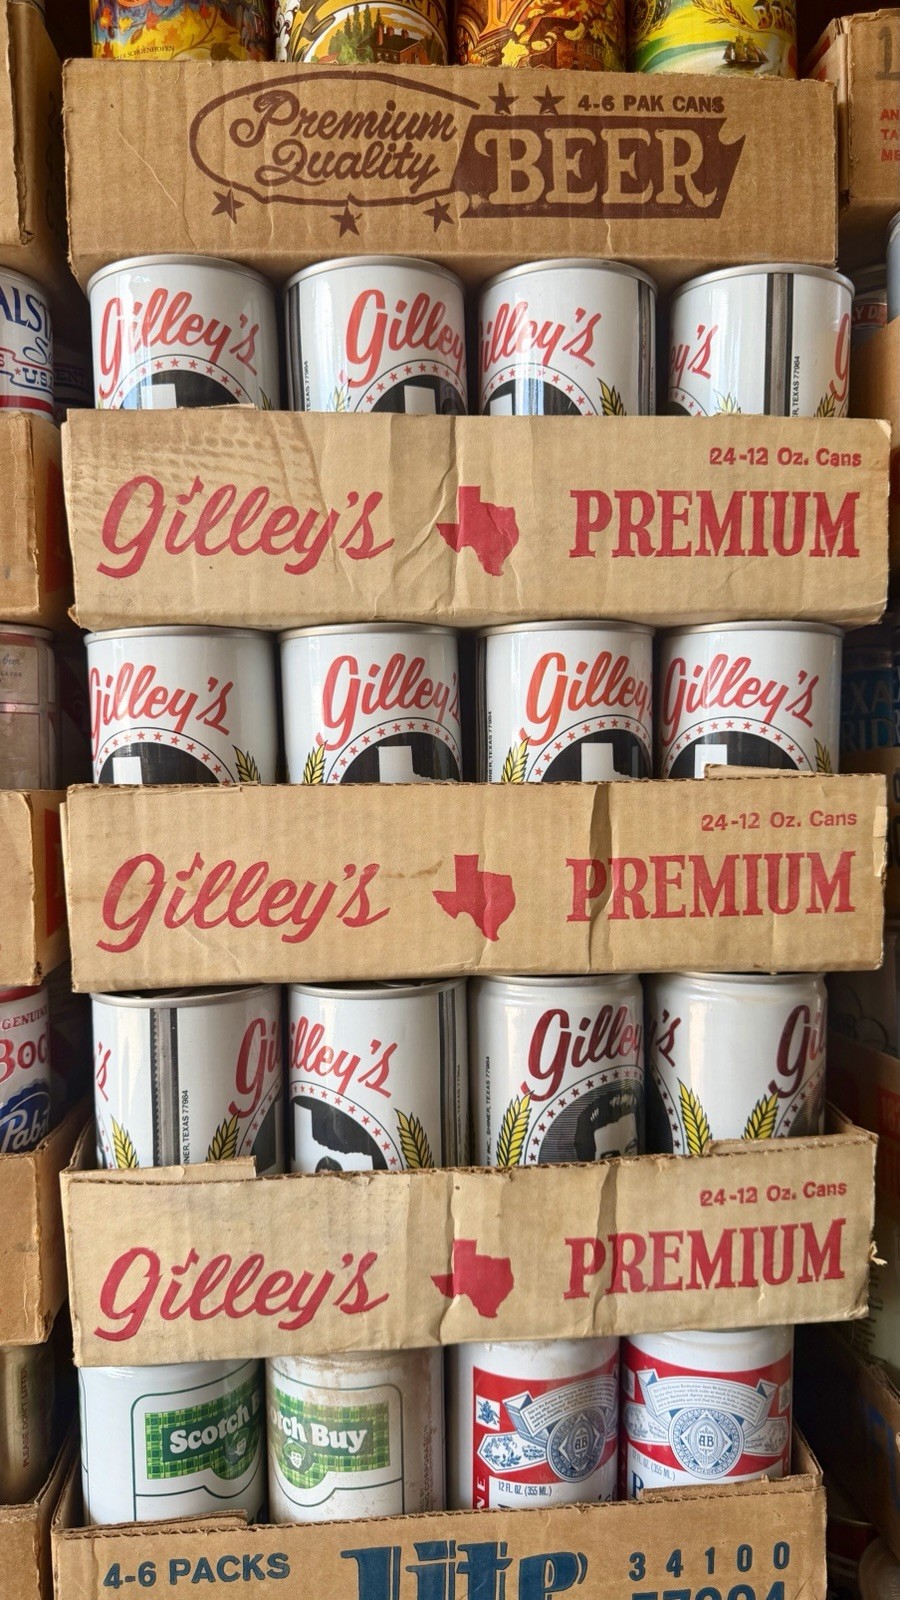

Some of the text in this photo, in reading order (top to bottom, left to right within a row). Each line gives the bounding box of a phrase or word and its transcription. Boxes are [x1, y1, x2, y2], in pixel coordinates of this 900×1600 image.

[229, 89, 458, 148] Premium
[577, 94, 725, 113] 4-6 PAK CANS
[254, 138, 440, 194] Quality
[474, 127, 718, 210] BEER
[99, 287, 260, 398] Gilley's
[339, 289, 464, 389] Gilley
[480, 301, 602, 373] illey's
[792, 381, 800, 406] TEXAS
[709, 447, 862, 467] 24-12 Oz. Cans
[96, 475, 395, 579] Gilley's
[569, 489, 860, 558] PREMIUM
[89, 662, 234, 762] Gilley's
[519, 651, 651, 747] Gilley
[661, 653, 819, 747] Gilley's
[701, 810, 858, 831] 24-12 Oz. Cans
[96, 852, 391, 953] Gilley's
[566, 850, 856, 922] PREMIUM
[2, 1005, 47, 1030] GENUIN
[289, 1016, 397, 1099] illey's
[521, 1004, 642, 1102] Gilley
[182, 1115, 190, 1142] TEXAS
[700, 1181, 848, 1207] 24-12 Oz. Cans
[563, 1218, 847, 1300] PREMIUM
[94, 1247, 390, 1342] Gilley's
[22, 1432, 30, 1468] PLEASE
[169, 1405, 250, 1454] Scotch
[271, 1406, 367, 1453] otch Buy
[698, 1435, 715, 1447] AB
[498, 1480, 505, 1491] 12
[524, 1485, 538, 1497] (355
[103, 1552, 290, 1590] 4-6 PACKS
